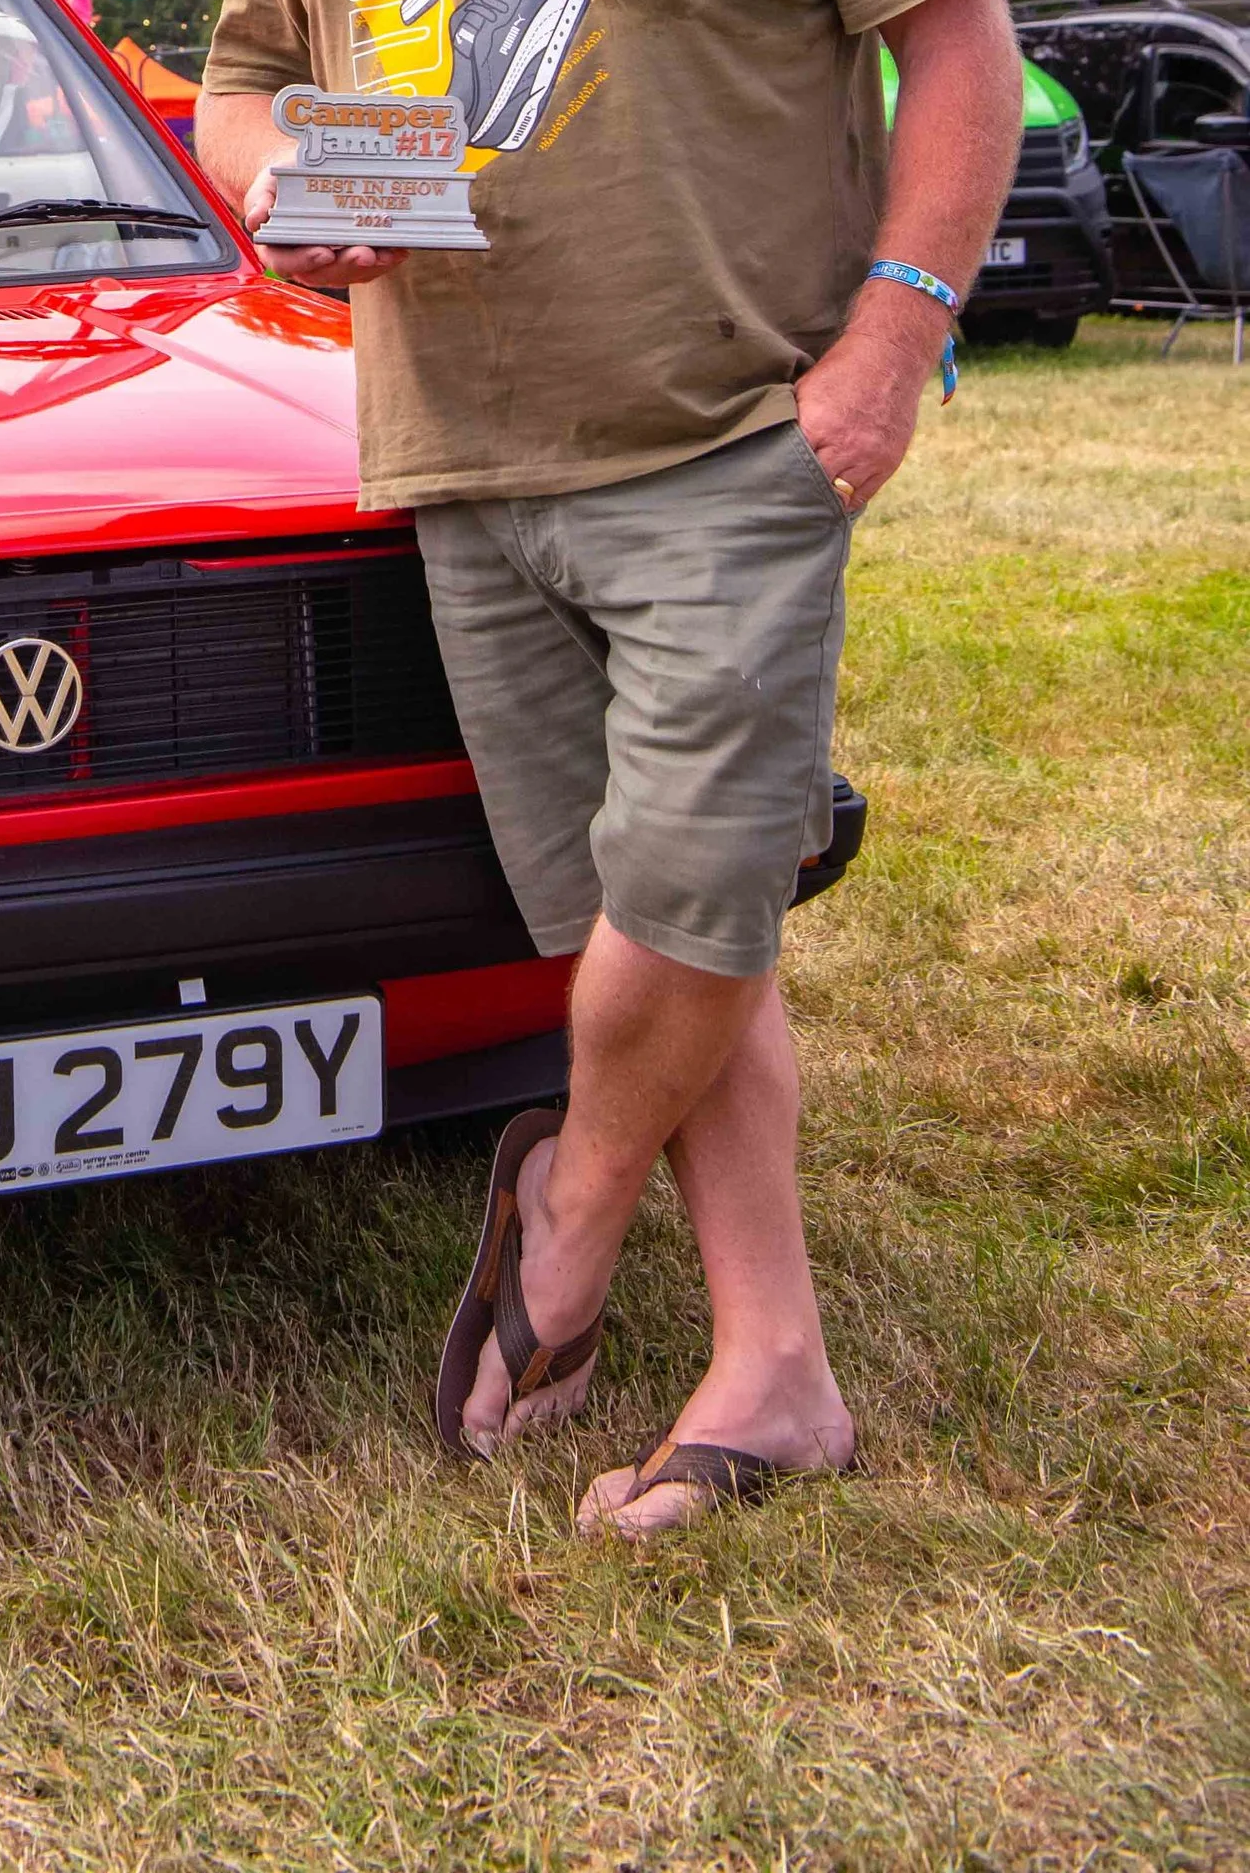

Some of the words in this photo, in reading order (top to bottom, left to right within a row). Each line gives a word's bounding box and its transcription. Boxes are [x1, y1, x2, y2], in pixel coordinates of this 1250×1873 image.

[500, 25, 520, 57] PUMA
[284, 98, 453, 136] Camper
[511, 113, 533, 144] PUMA
[395, 131, 456, 158] #17
[306, 179, 357, 194] BEST
[360, 180, 386, 195] IN
[390, 181, 449, 197] SHOW
[333, 194, 413, 210] WINNER
[52, 1012, 361, 1156] 279Y
